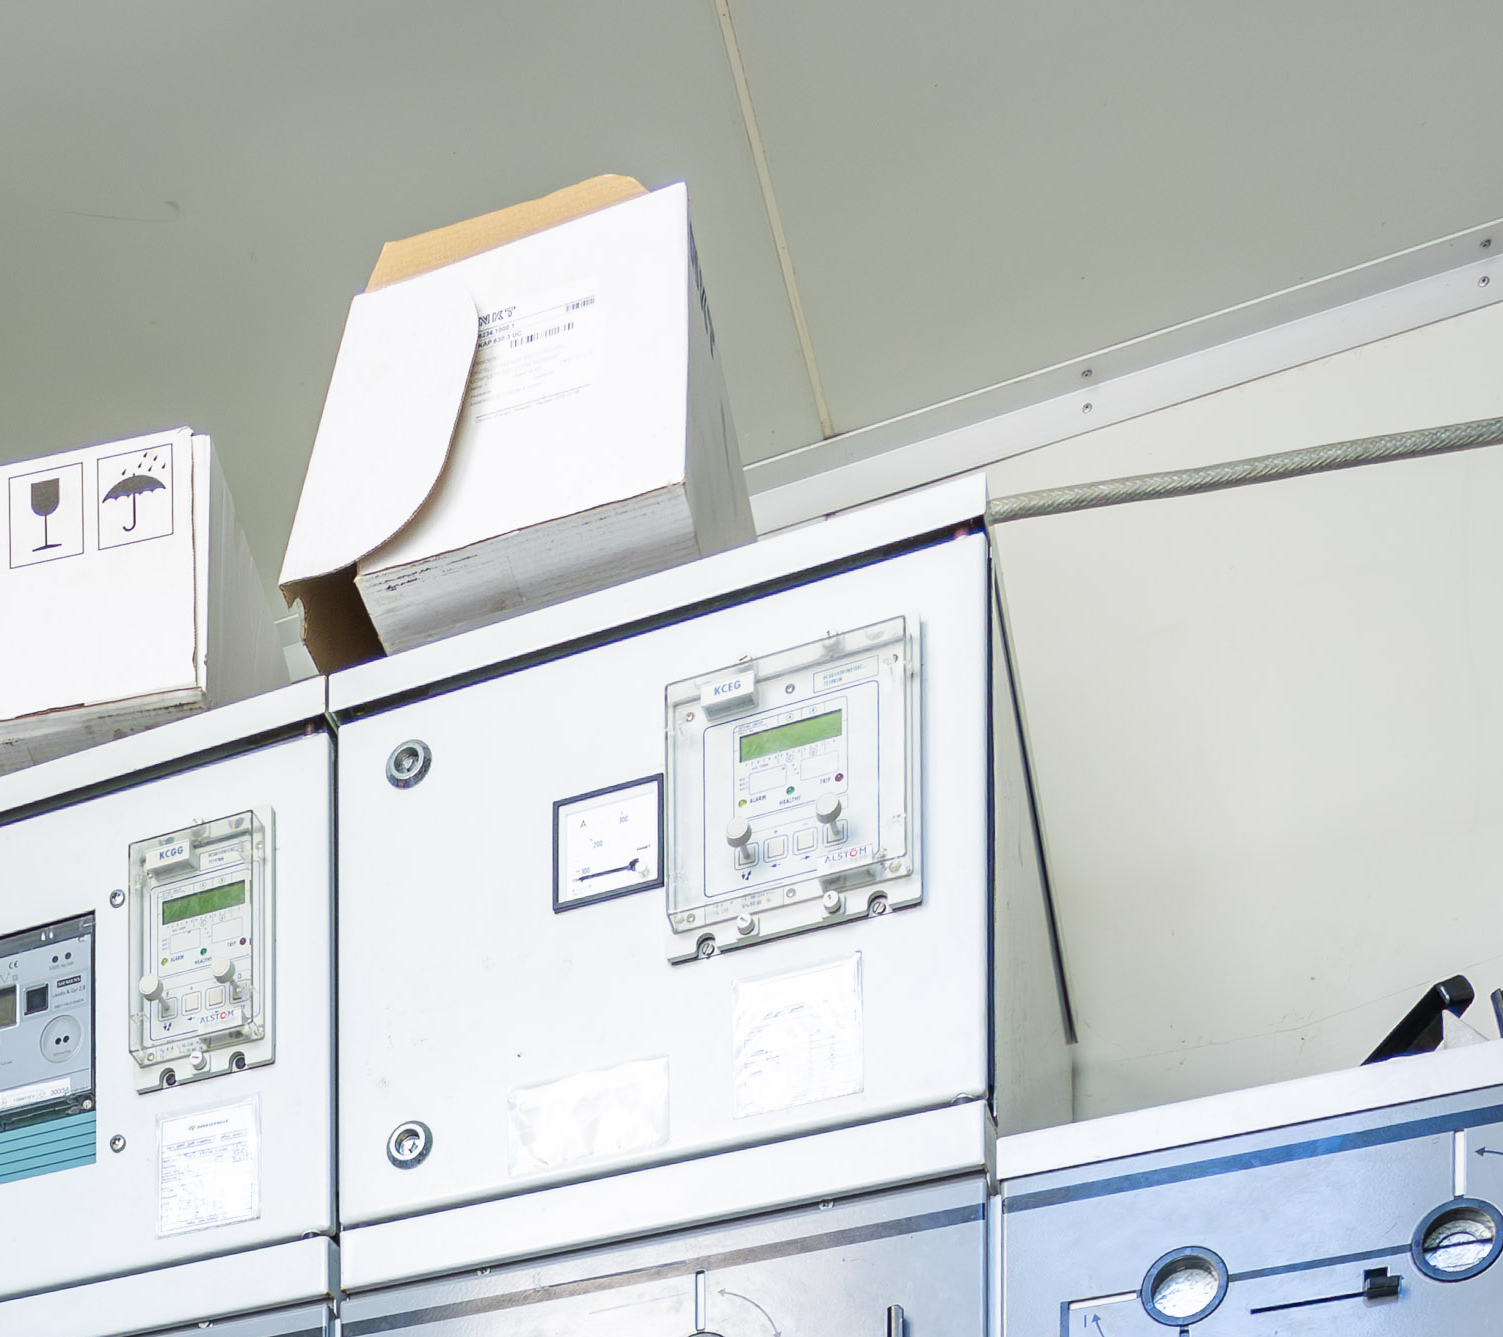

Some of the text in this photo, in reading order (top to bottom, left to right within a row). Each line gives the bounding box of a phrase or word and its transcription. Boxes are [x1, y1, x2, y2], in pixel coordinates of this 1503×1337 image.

[478, 306, 516, 327] NKT
[714, 680, 742, 696] KCEG
[749, 795, 767, 805] ALARM
[159, 845, 184, 861] KCGG
[824, 846, 867, 864] ALSTOM
[200, 1010, 234, 1024] ALSTOM
